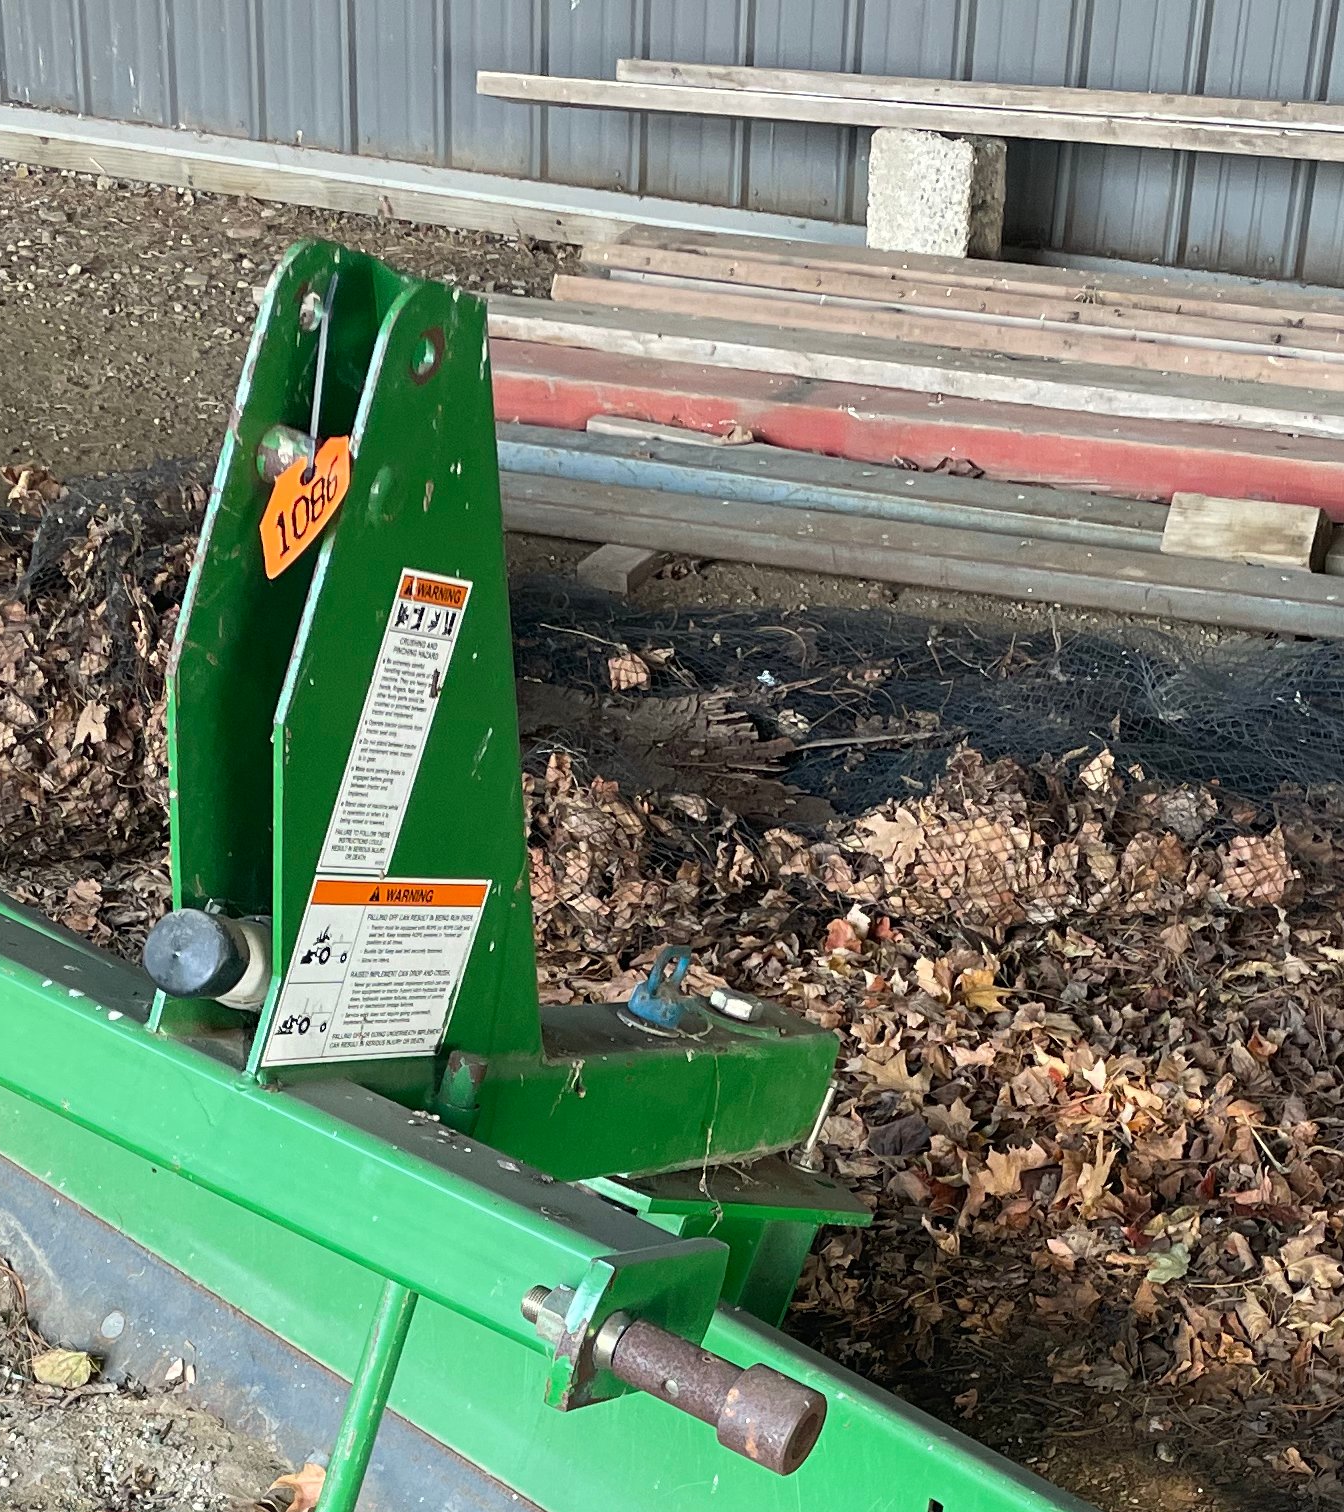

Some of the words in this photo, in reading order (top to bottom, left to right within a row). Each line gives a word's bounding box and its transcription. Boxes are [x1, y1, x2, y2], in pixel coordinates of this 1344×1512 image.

[275, 455, 339, 558] 1086
[416, 583, 462, 604] WARNING
[427, 641, 438, 650] AND
[386, 888, 434, 903] WARNING
